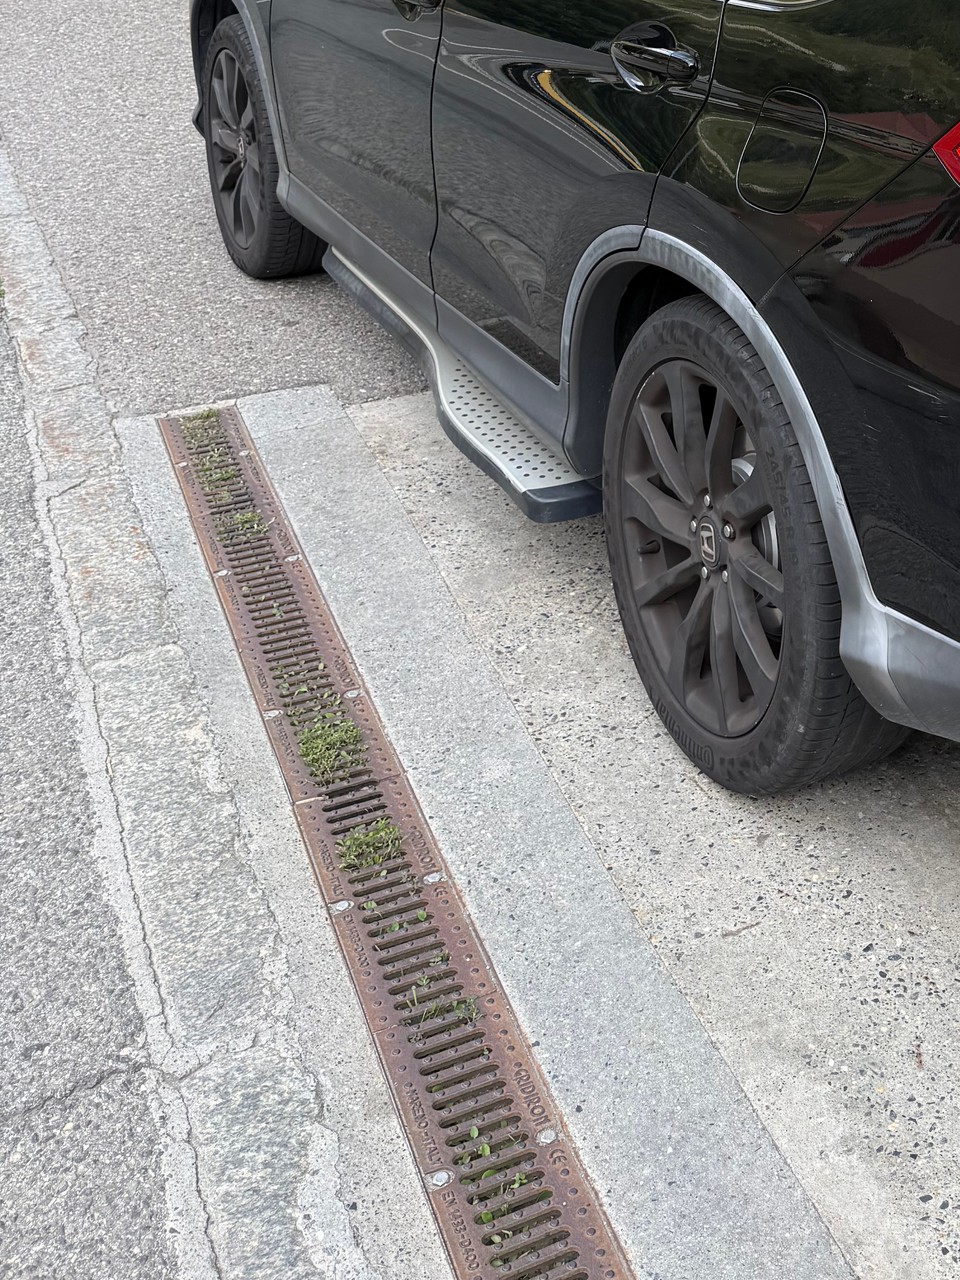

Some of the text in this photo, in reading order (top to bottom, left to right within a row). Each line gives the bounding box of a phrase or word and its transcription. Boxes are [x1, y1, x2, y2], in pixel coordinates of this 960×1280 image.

[512, 1068, 552, 1128] GRIDIRON
[548, 1148, 568, 1167] CE
[441, 1191, 457, 1208] EN
